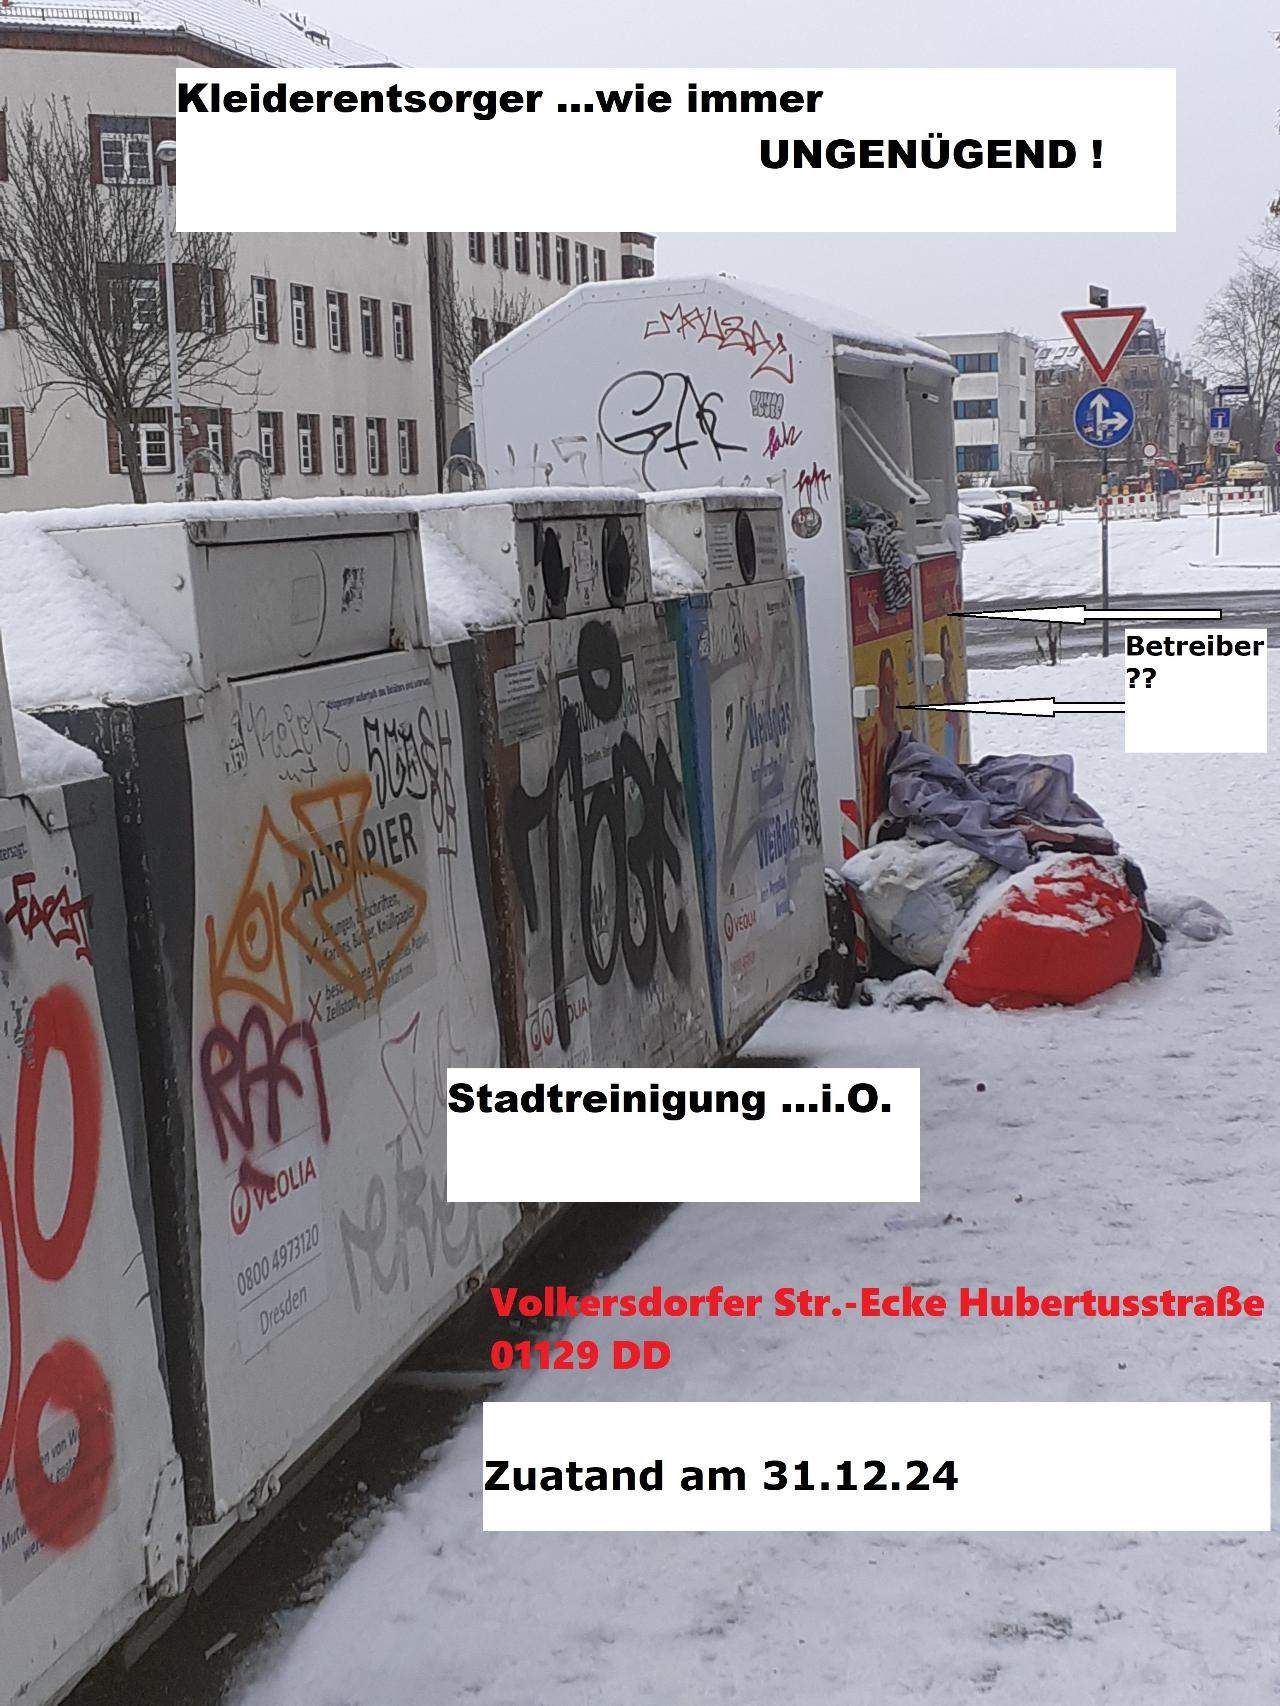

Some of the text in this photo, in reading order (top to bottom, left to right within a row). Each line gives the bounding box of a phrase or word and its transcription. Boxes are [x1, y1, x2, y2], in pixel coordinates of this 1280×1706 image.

[237, 1223, 320, 1297] 0800 4973120
[259, 1284, 309, 1336] Dresden
